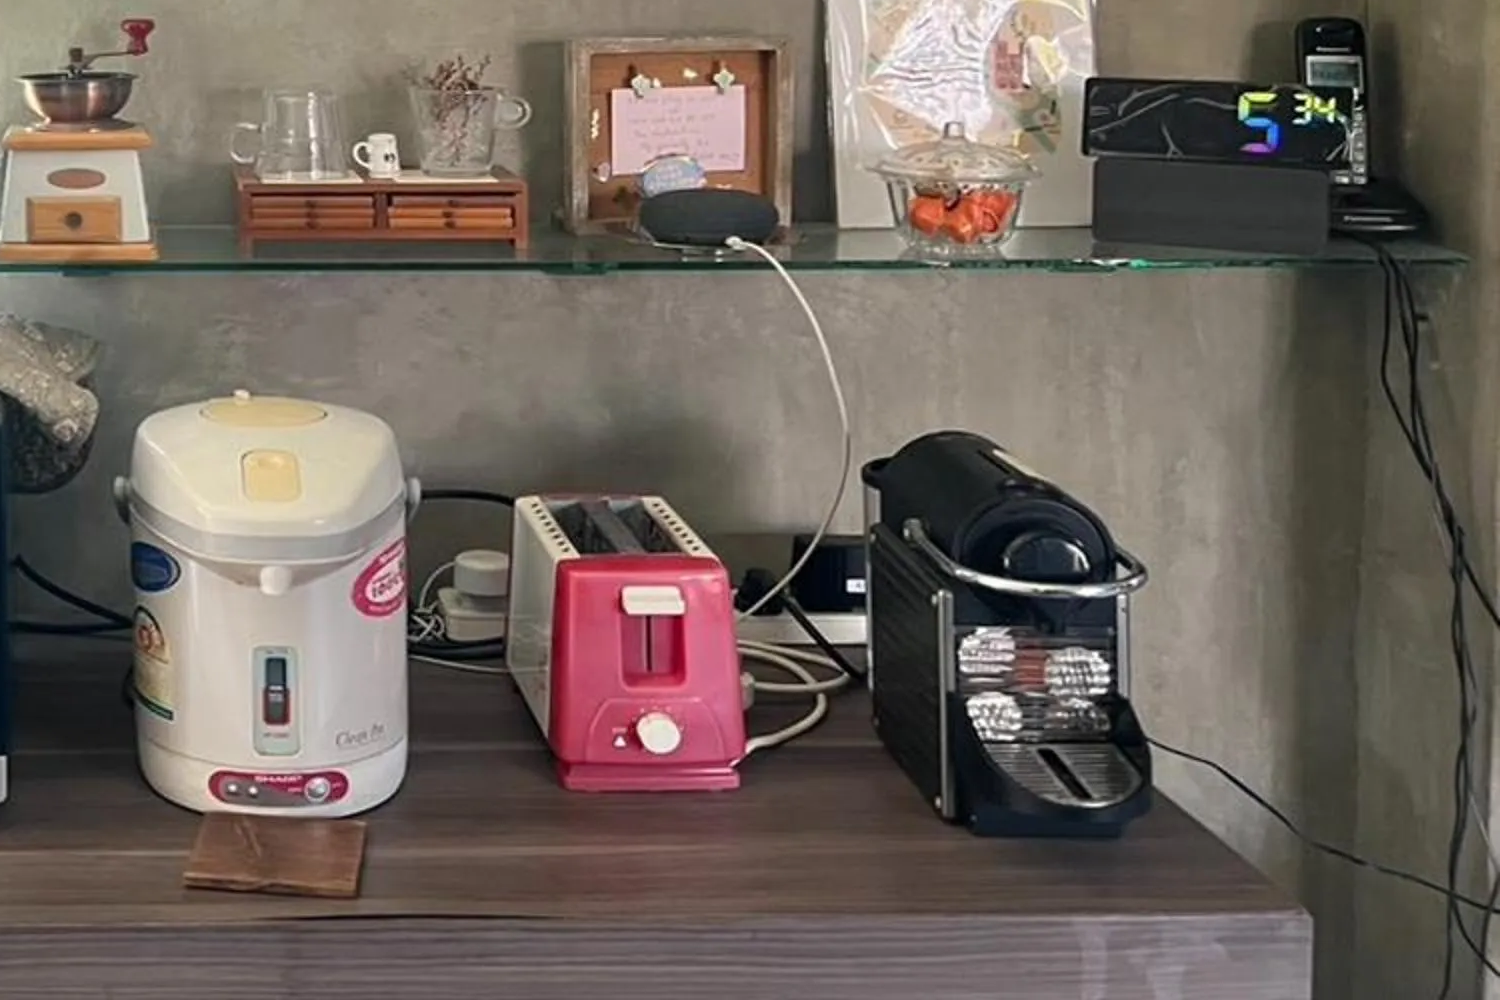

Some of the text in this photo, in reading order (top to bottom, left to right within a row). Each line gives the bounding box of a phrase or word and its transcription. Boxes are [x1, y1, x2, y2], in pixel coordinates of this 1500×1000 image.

[1238, 92, 1337, 153] 5 34
[254, 774, 303, 783] SHARP
